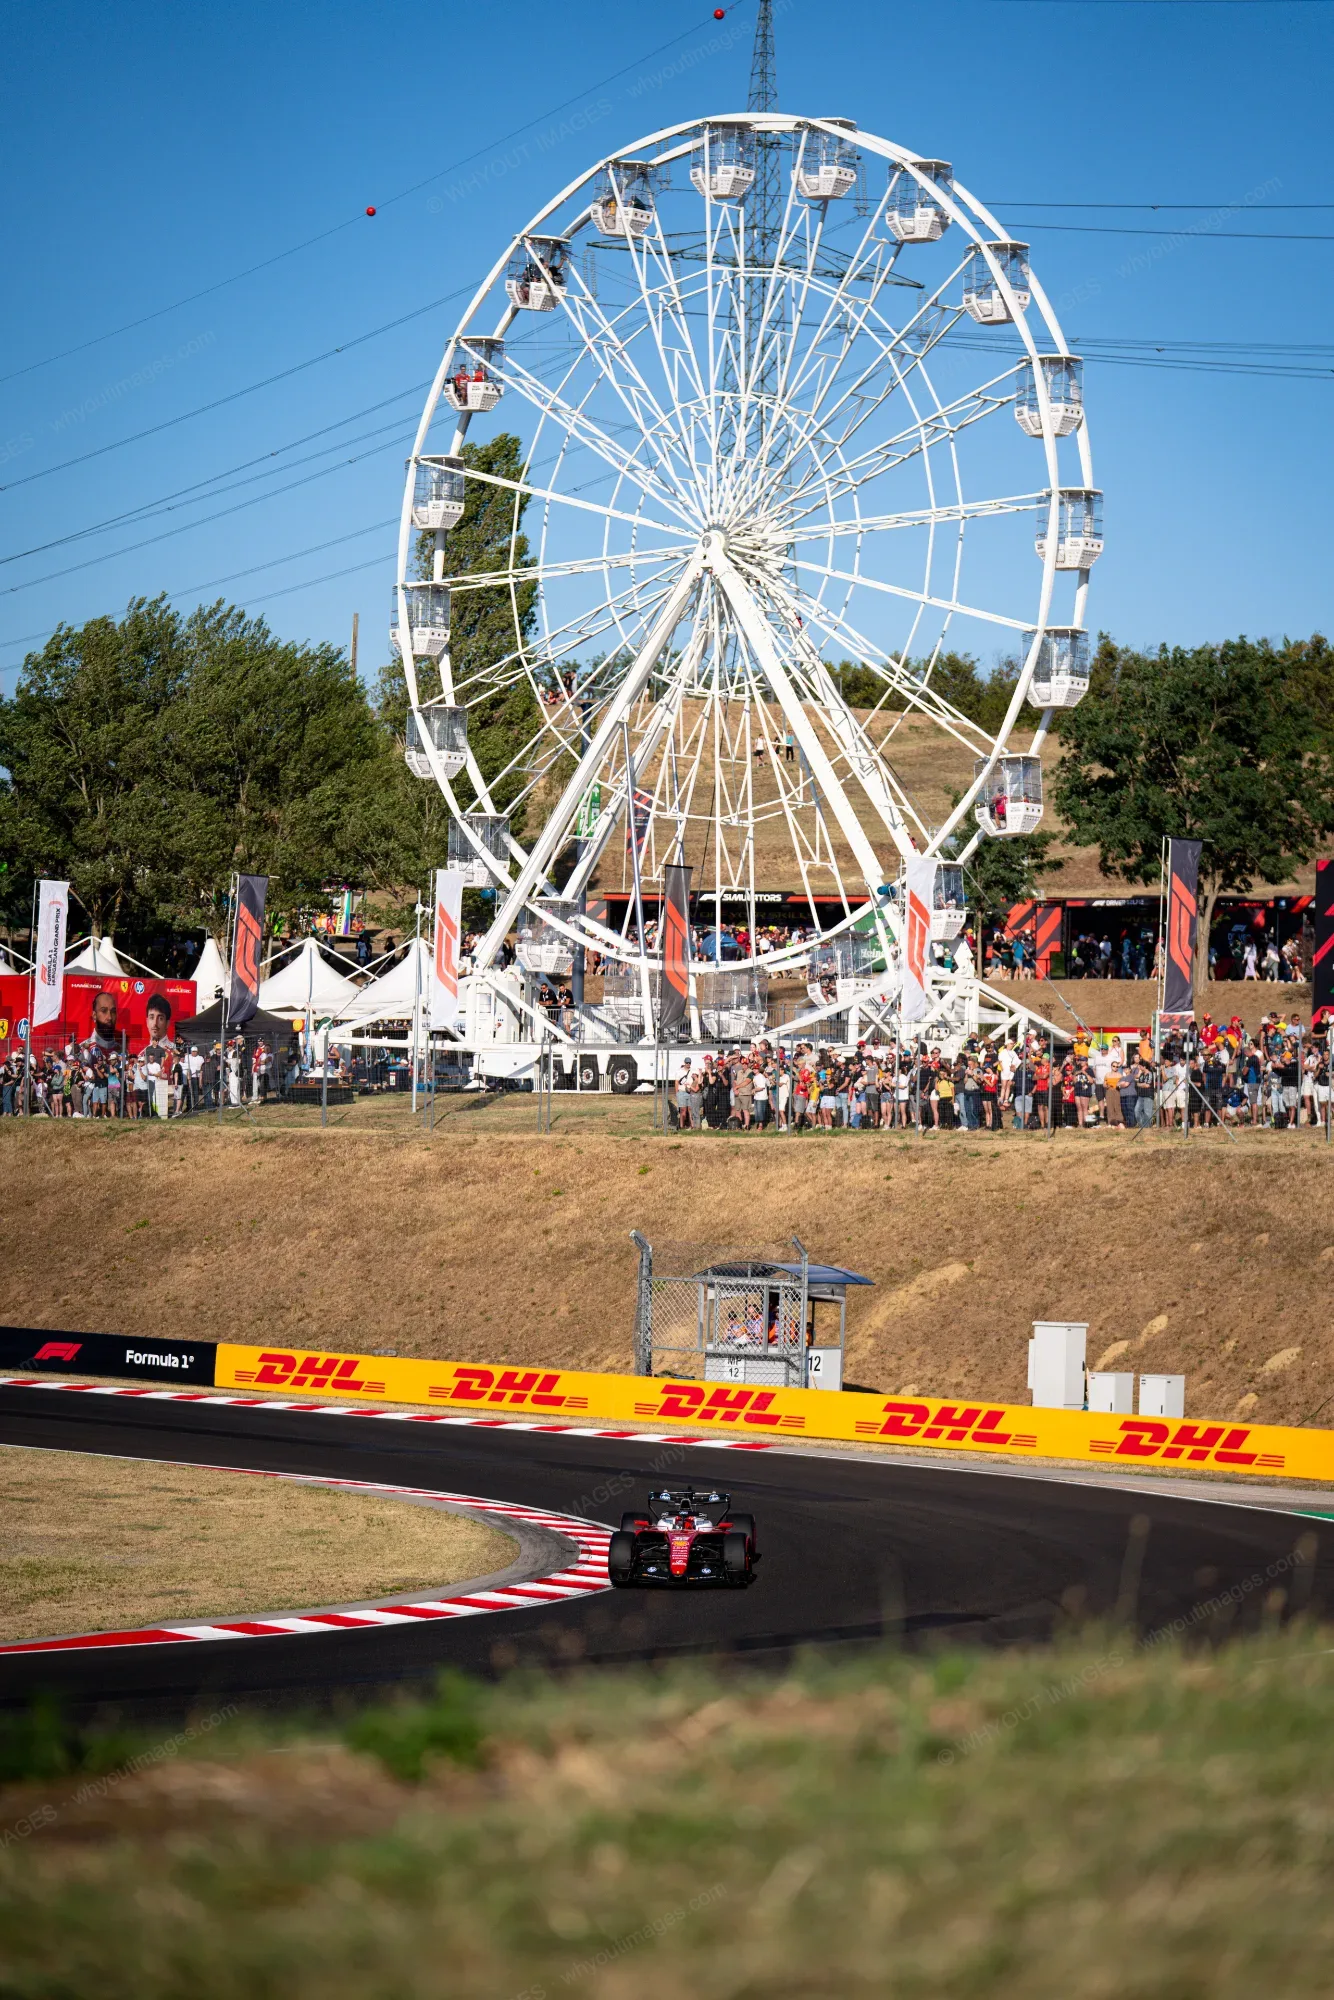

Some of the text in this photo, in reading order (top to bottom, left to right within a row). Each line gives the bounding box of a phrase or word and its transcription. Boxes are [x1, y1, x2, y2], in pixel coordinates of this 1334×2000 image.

[722, 893, 782, 902] SIMUTORS
[125, 1349, 179, 1368] Formula
[254, 1354, 365, 1391] DHL
[728, 1367, 739, 1378] 12
[808, 1355, 821, 1372] 12
[449, 1368, 567, 1407] DHL
[657, 1384, 782, 1426] DHL
[879, 1402, 1012, 1445] DHL
[1115, 1421, 1258, 1465] DHL
